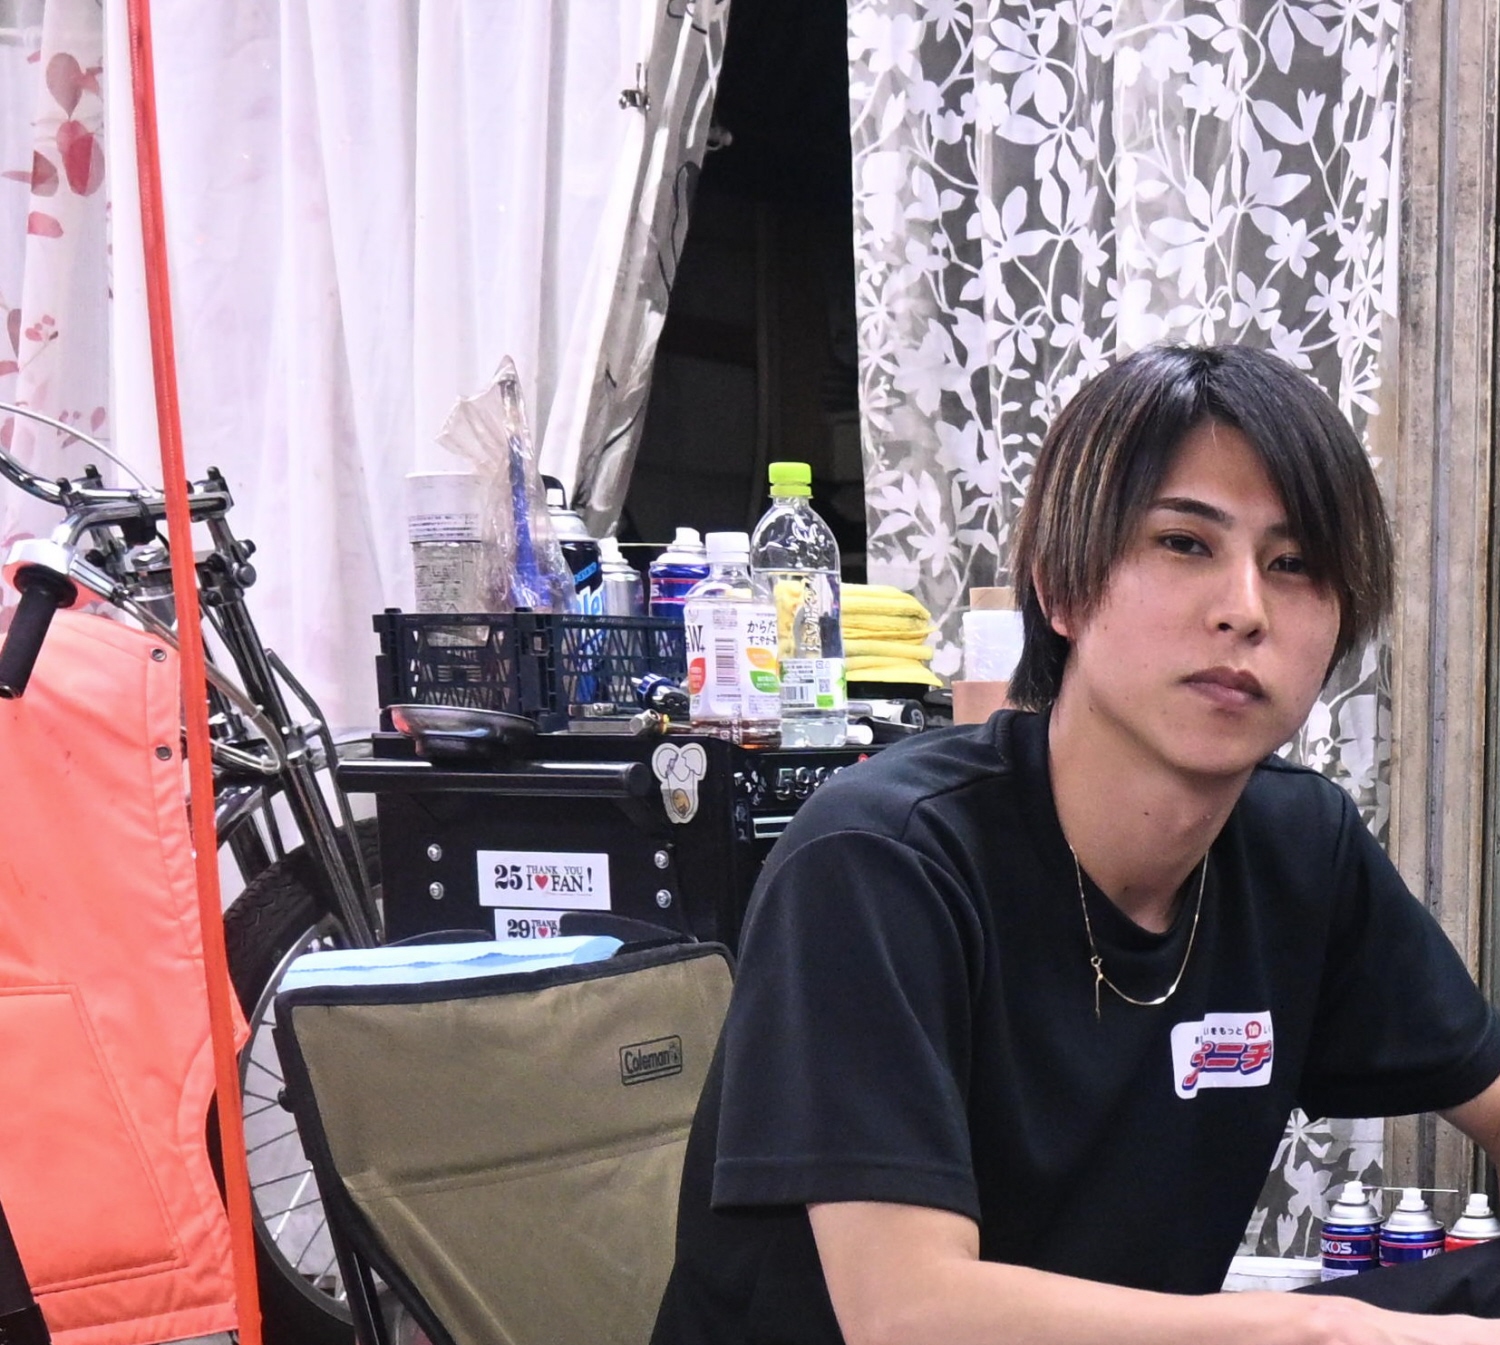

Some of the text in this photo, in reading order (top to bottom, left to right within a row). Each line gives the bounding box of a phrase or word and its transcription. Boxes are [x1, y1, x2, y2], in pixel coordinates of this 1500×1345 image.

[494, 864, 523, 891] 25
[526, 864, 583, 876] THANK YOU
[507, 918, 531, 939] 29
[530, 919, 557, 928] THANK
[624, 1048, 671, 1074] Coleman
